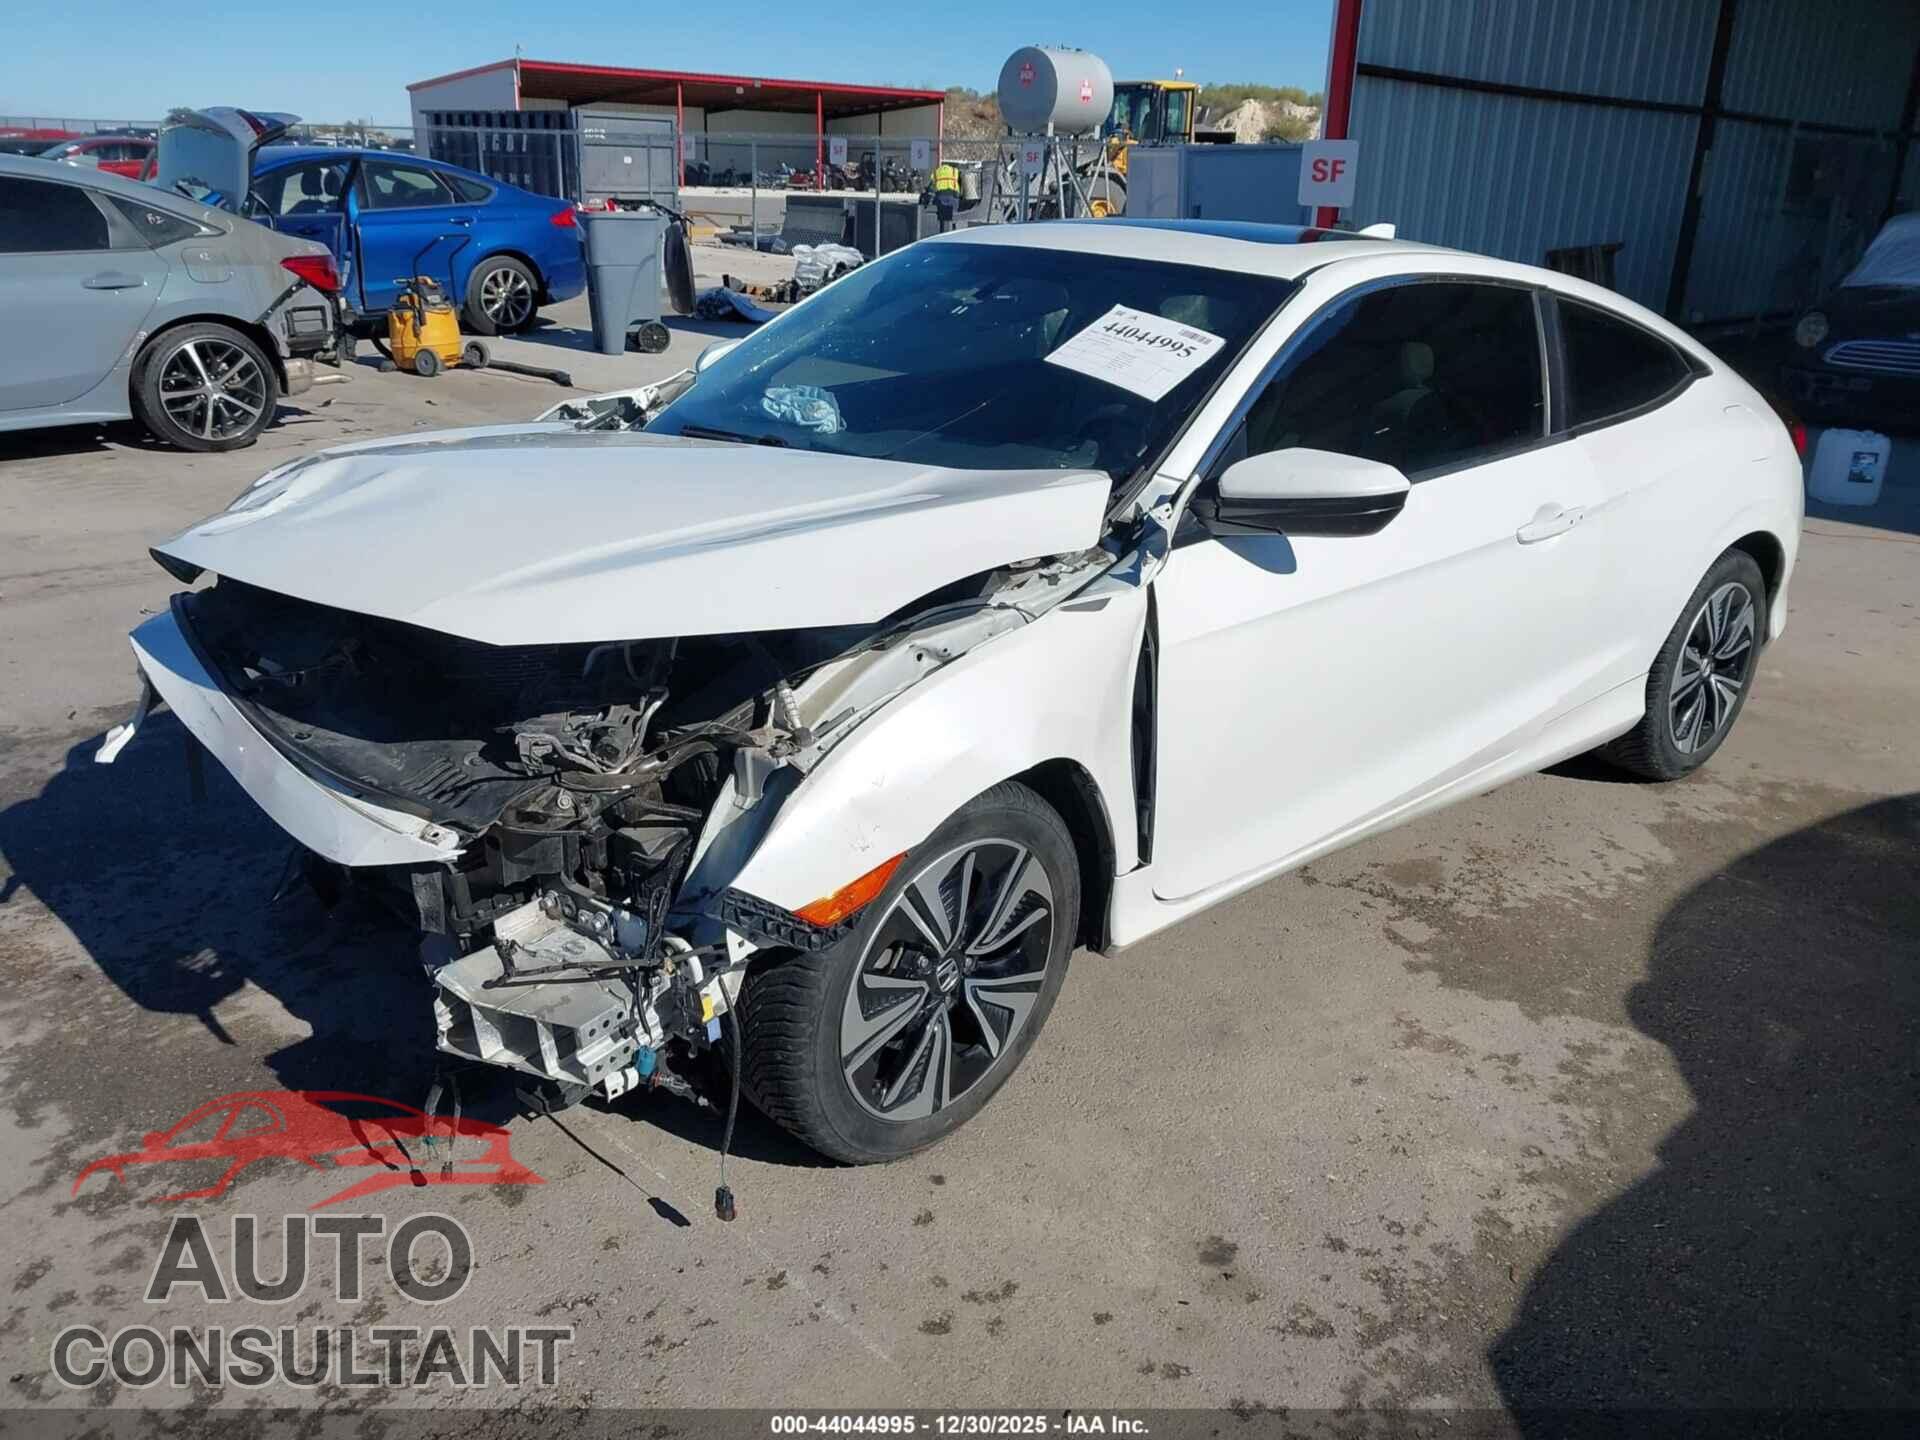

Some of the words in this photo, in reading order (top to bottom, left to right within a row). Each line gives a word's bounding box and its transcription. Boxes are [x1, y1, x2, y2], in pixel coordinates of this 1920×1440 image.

[1026, 151, 1039, 162] SF
[1311, 158, 1346, 184] SF
[1102, 321, 1198, 359] 44044995
